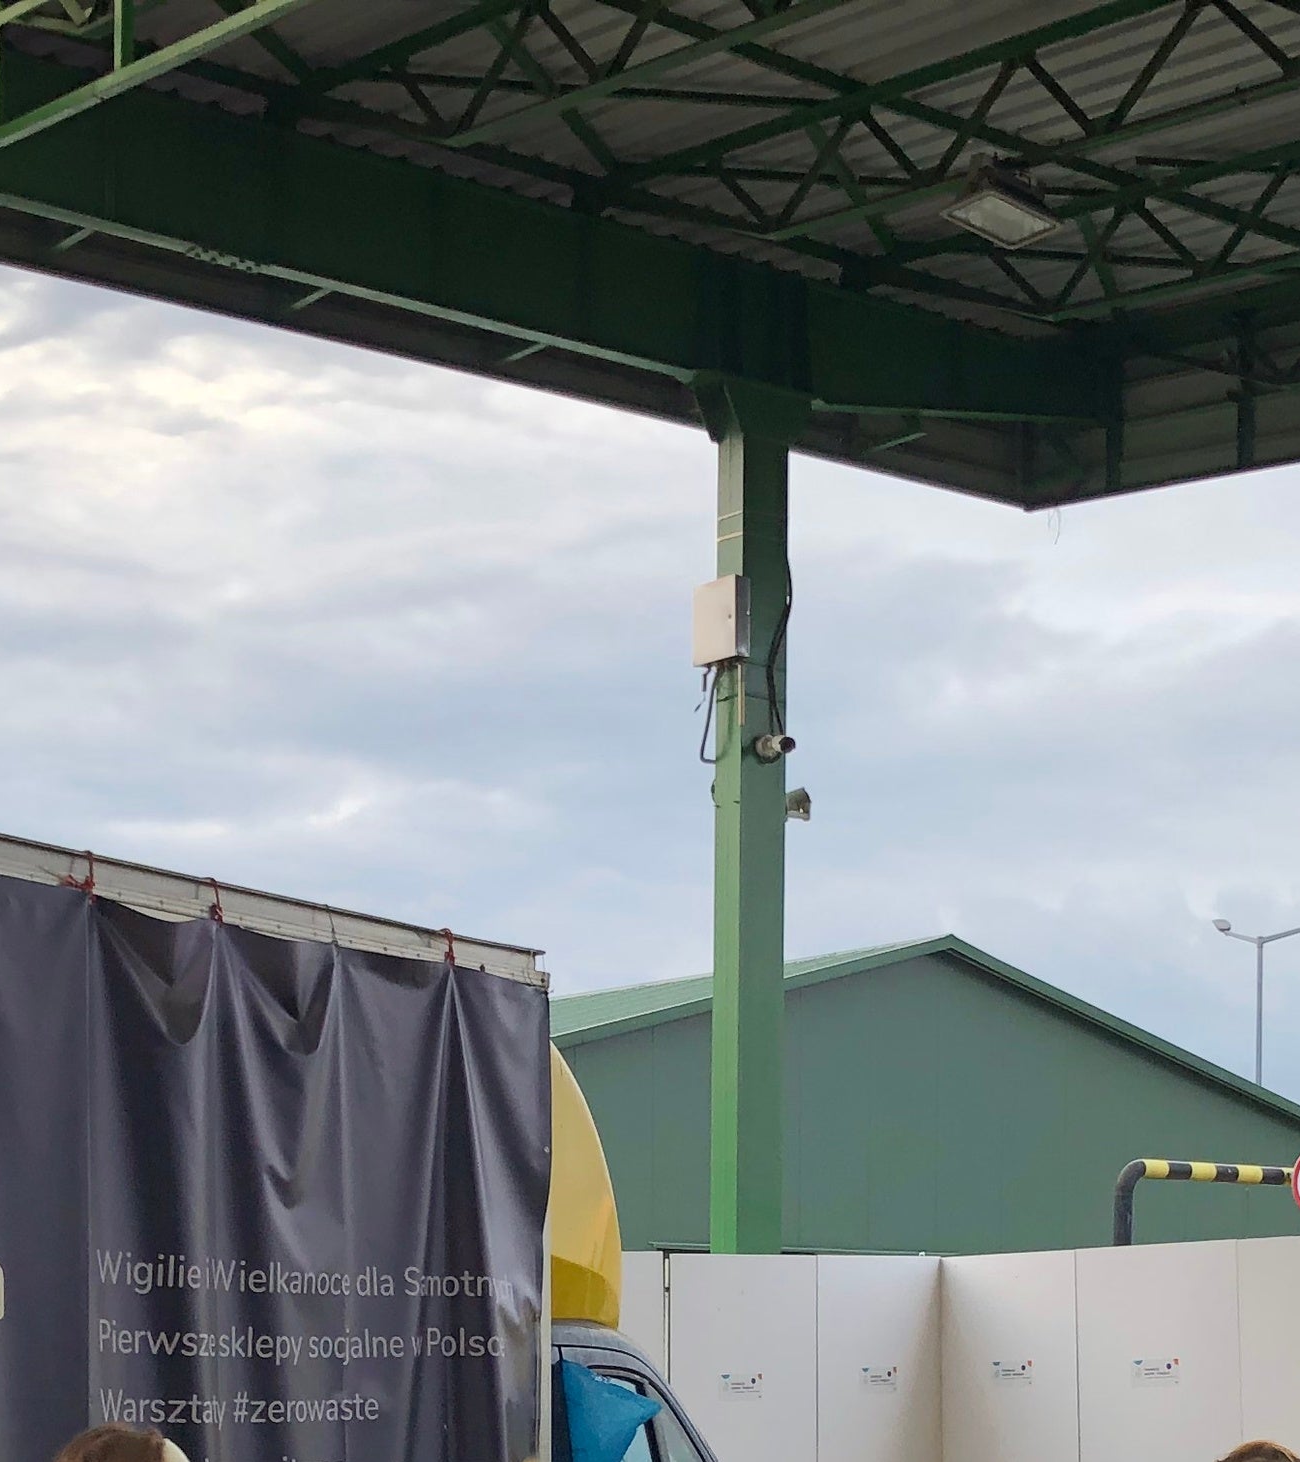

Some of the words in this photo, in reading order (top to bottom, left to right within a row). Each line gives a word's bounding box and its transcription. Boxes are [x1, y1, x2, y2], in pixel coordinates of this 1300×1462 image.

[96, 1248, 202, 1295] Wigilie
[211, 1258, 351, 1297] Wielkanoce
[356, 1265, 395, 1297] dla
[98, 1317, 216, 1357] Pierwsze
[218, 1324, 304, 1366] sklepy
[308, 1327, 405, 1367] socjalne
[99, 1387, 227, 1430] Warsztaty
[232, 1390, 381, 1425] #zerowaste
